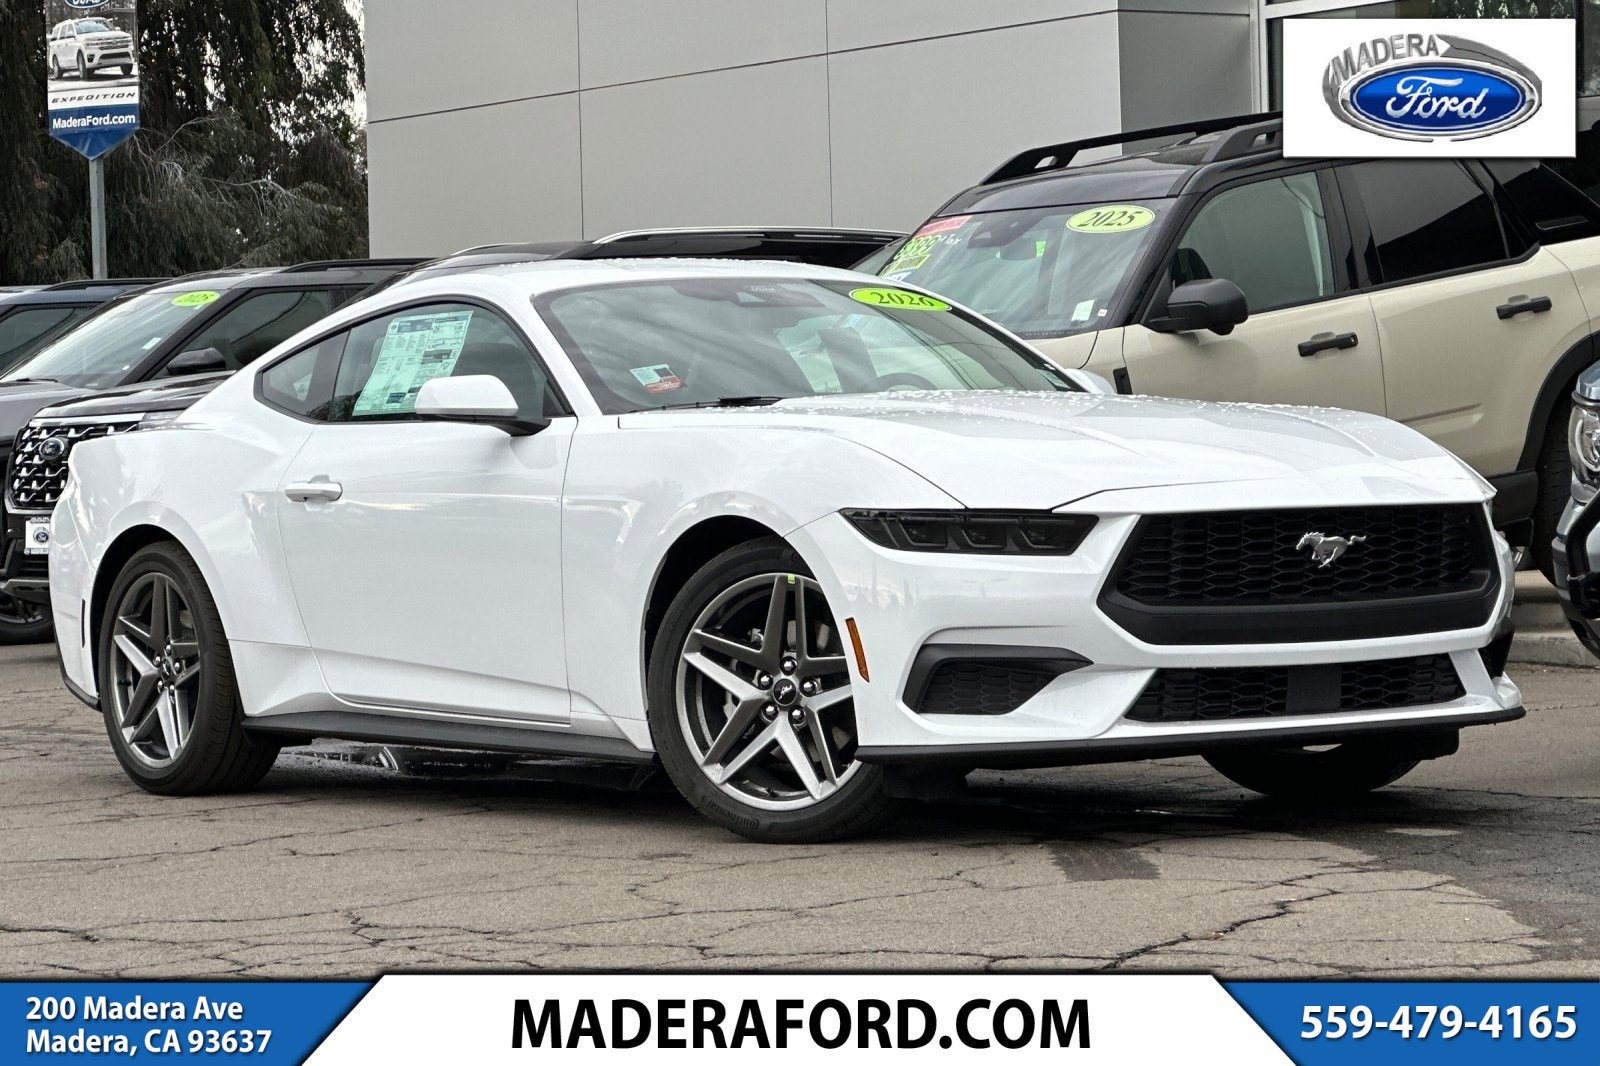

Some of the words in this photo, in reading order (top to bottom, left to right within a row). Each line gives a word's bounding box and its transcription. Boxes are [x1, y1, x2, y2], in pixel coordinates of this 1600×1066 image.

[51, 92, 136, 104] EXPEDITION
[52, 113, 136, 129] MaderaFord.com
[1076, 211, 1144, 227] 2025
[870, 291, 935, 307] 2026
